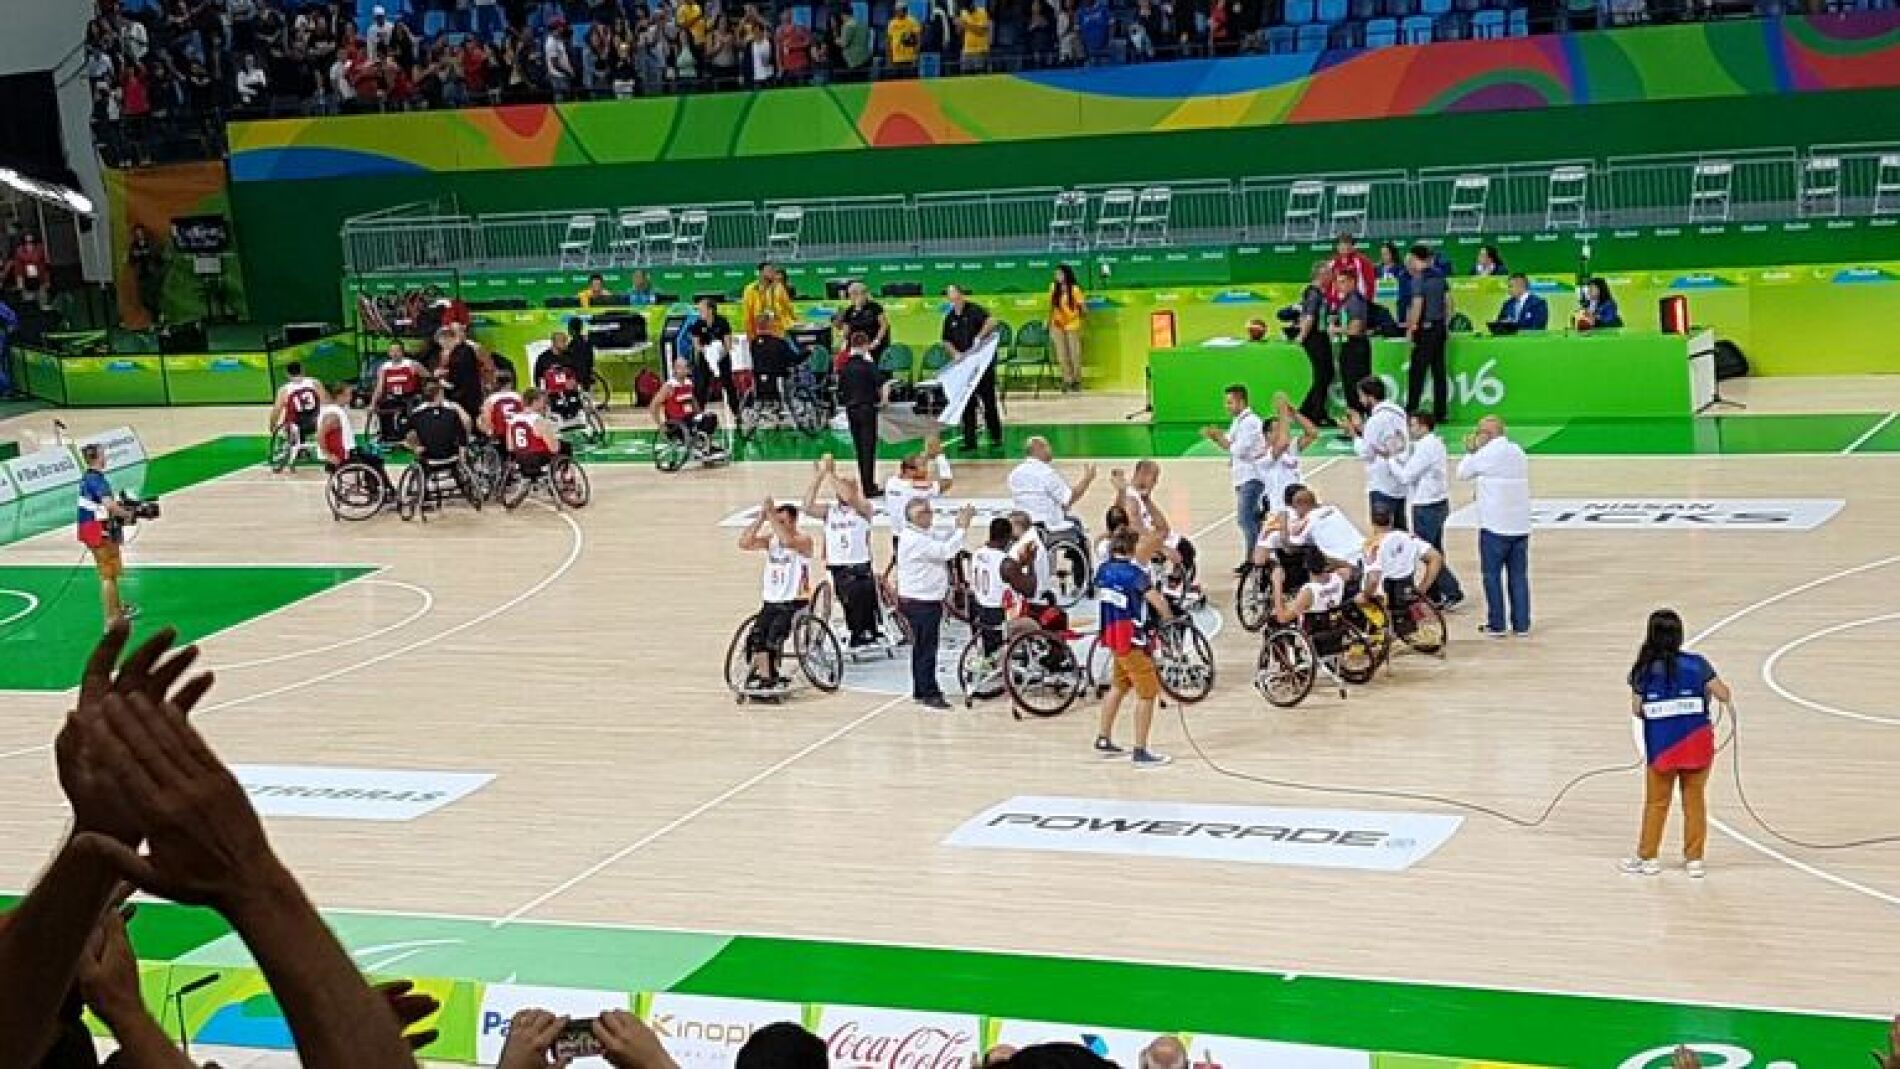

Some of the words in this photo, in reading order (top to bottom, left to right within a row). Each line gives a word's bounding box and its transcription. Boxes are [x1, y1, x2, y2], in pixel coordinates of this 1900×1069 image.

[293, 391, 316, 412] 13
[515, 428, 528, 448] 6
[840, 534, 849, 549] 5
[987, 812, 1390, 847] POWERADE
[652, 1013, 756, 1045] Kinopl
